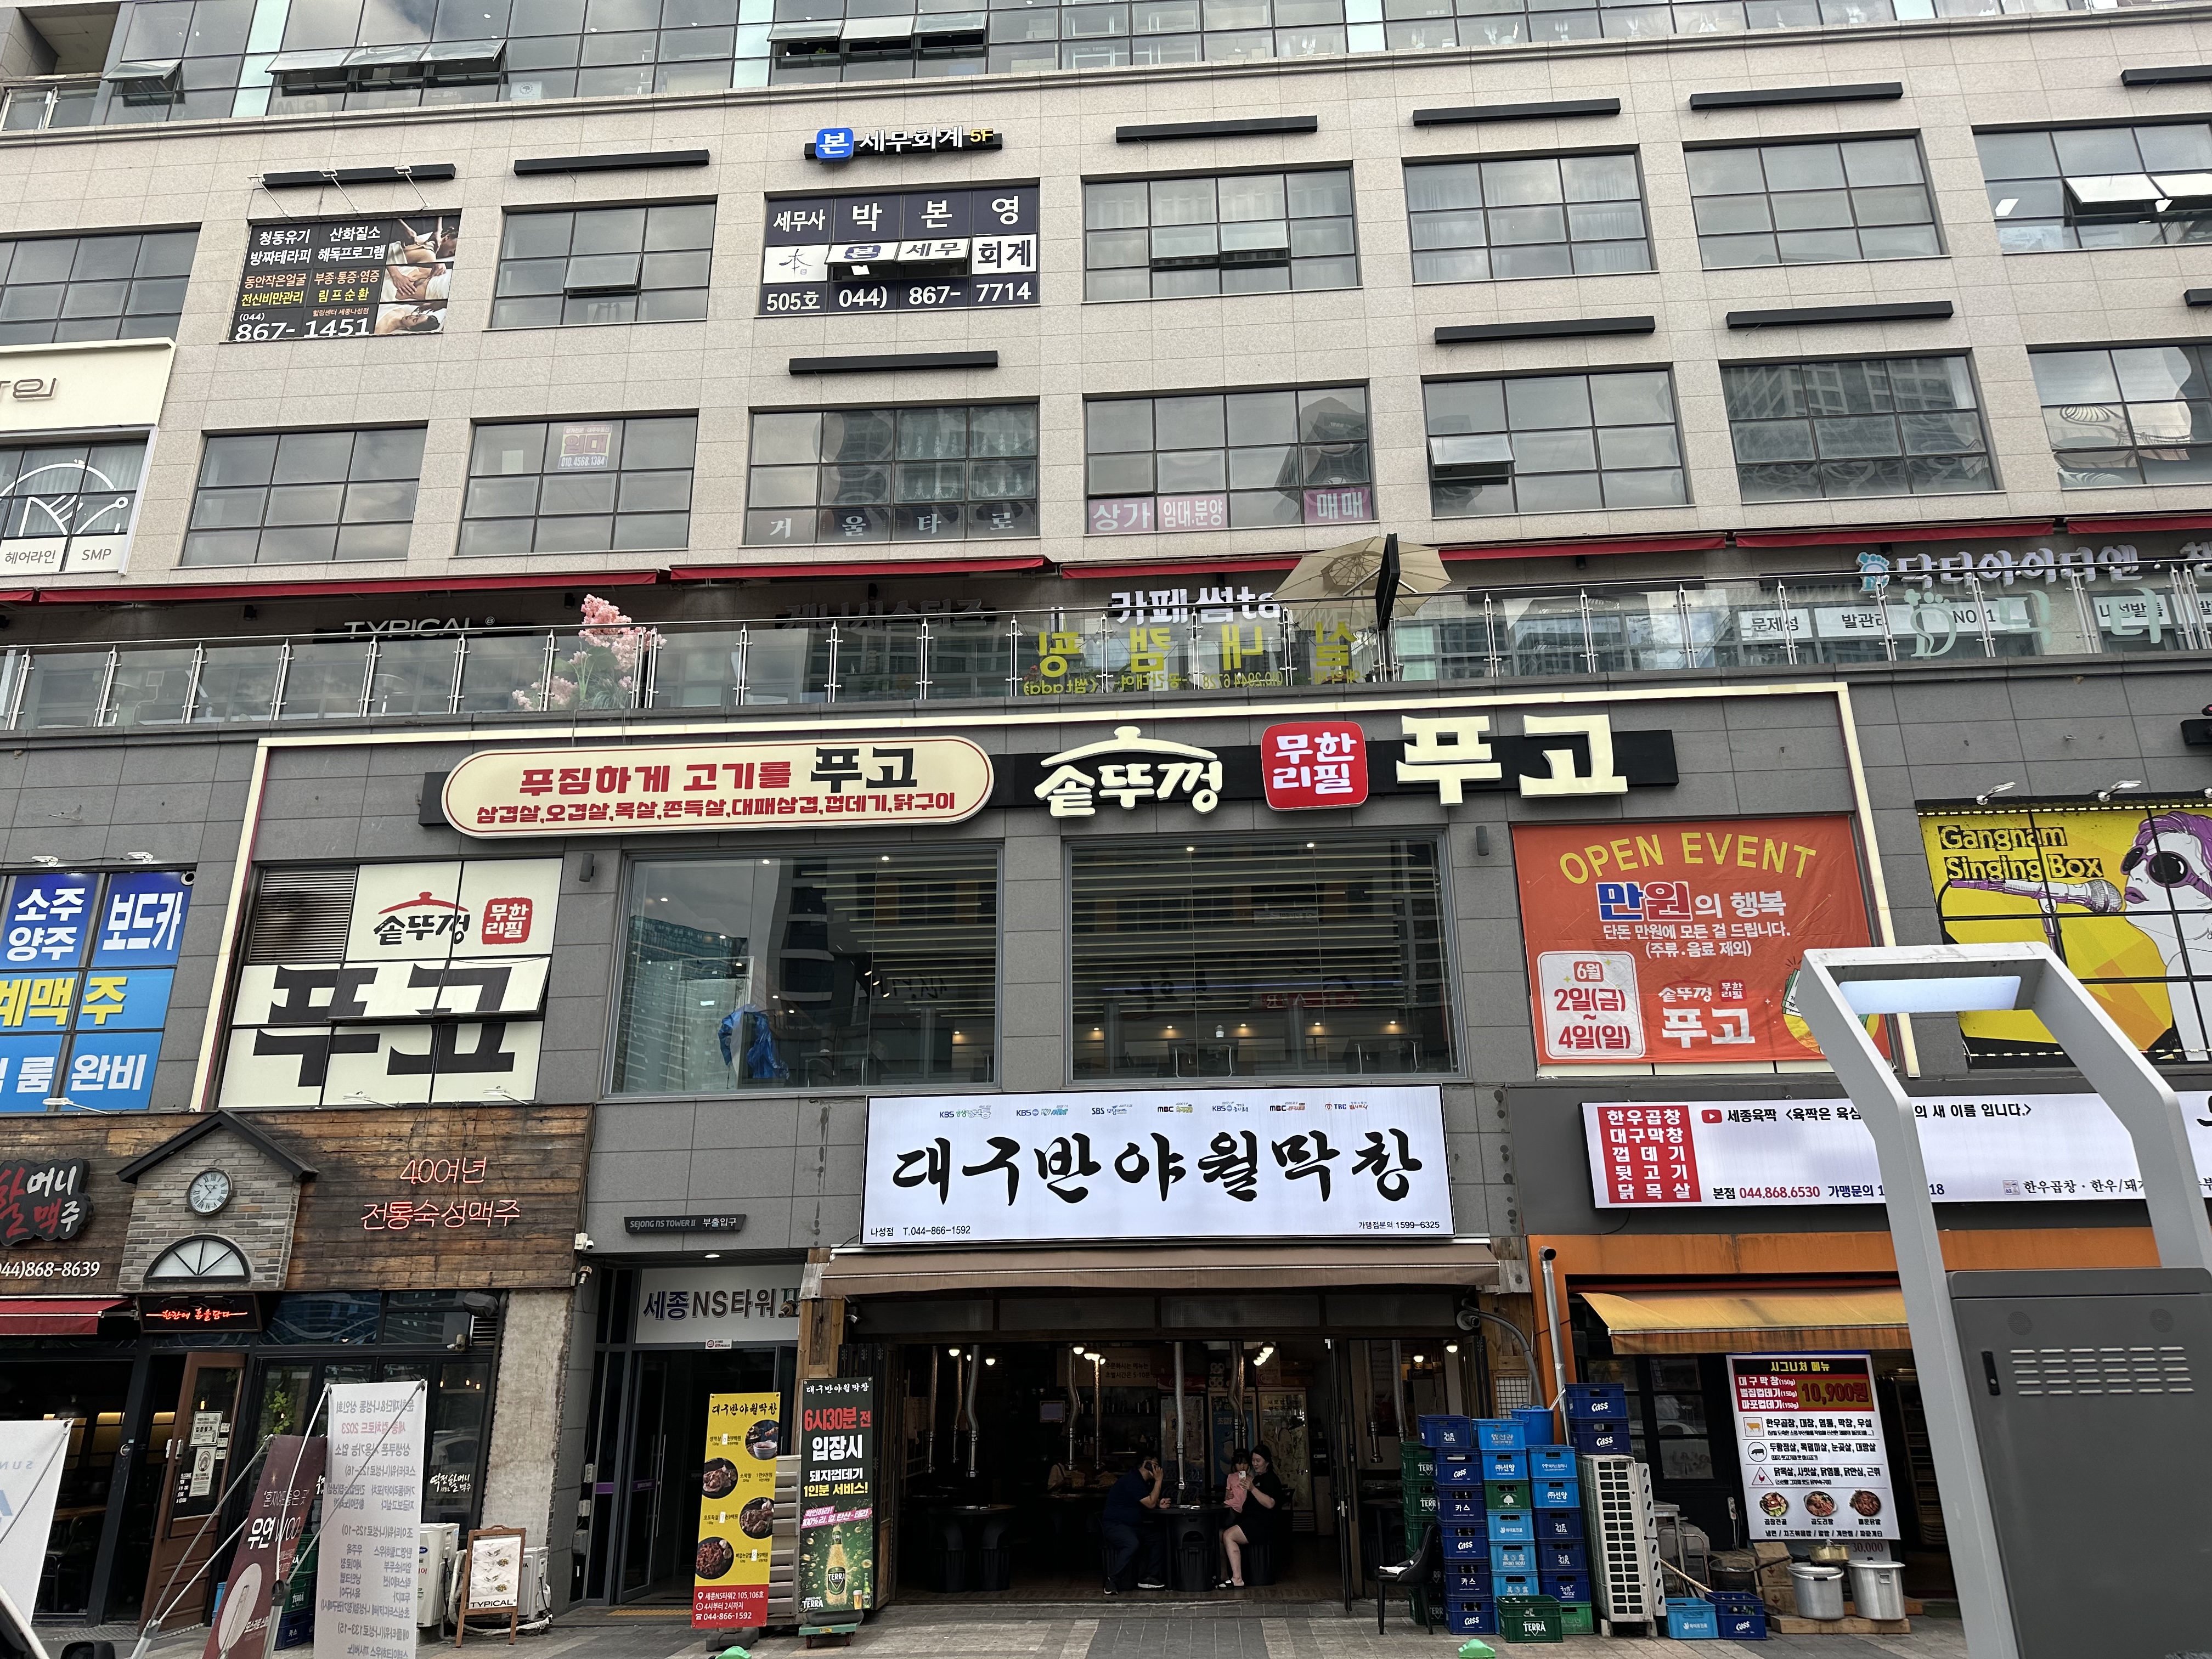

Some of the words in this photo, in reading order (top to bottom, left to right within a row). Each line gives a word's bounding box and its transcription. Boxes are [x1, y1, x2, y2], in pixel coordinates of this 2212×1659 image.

[819, 132, 850, 155] 본
[859, 126, 963, 153] 세무회계
[969, 128, 994, 143] 5F
[773, 209, 826, 232] 세무사
[258, 228, 311, 246] 청동유기
[329, 225, 381, 242] 산화질소
[250, 248, 312, 267] 방짜테라피
[317, 244, 386, 263] 해독프로그램
[905, 242, 962, 257] 세무
[978, 239, 1032, 268] 회계
[244, 272, 307, 290] 동안작은얼굴
[240, 289, 304, 307] 전신비만관리
[766, 290, 821, 312] 505호
[838, 286, 888, 309] 044)
[909, 285, 961, 305] 867-
[976, 281, 1031, 302] 7714
[239, 312, 265, 321] (044)
[303, 318, 370, 338] 1451
[564, 435, 609, 454] 임대
[561, 455, 606, 467] 010.4568.1384
[1316, 492, 1363, 520] 매매
[1092, 503, 1150, 532] 상가
[4, 549, 57, 565] 헤어라인
[81, 548, 112, 562] SMP
[343, 617, 483, 640] TYPICAL
[1274, 731, 1356, 763] 무한
[1396, 714, 1629, 806] 푸고
[518, 763, 672, 797] 푸짐하게
[683, 760, 791, 792] 고기를
[810, 746, 918, 794] 푸고
[1272, 765, 1356, 795] 리필
[1034, 761, 1223, 819] 솥뚜껑
[1939, 826, 2067, 851] Gangnam
[1559, 833, 1664, 885] OPEN
[1681, 832, 1817, 879] EVENT
[1946, 856, 2044, 882] Singing
[2047, 854, 2104, 878] Box
[14, 887, 86, 922] 소주
[1595, 881, 1723, 923] 만원의
[1730, 890, 1787, 918] 행복
[102, 891, 184, 951] 보드카
[489, 903, 529, 921] 무한
[374, 914, 471, 946] 솥뚜껑
[485, 922, 527, 939] 리필
[1602, 924, 1632, 940] 단돈
[1634, 923, 1677, 940] 만원에
[1680, 923, 1709, 939] 모든
[1711, 923, 1727, 939] 걸
[1731, 921, 1791, 938] 드립니다.
[7, 926, 77, 962] 양주
[1719, 939, 1752, 957] 제외)
[1576, 962, 1602, 980] 6월
[1657, 985, 1713, 1003] 솥뚜껑
[1720, 981, 1744, 991] 무한
[1720, 991, 1744, 1000] 리필
[1554, 987, 1627, 1012] 2일(금)
[253, 962, 516, 1088] 푸고
[1661, 1006, 1756, 1049] 푸고
[1558, 1024, 1631, 1049] 4일(일)
[70, 1053, 148, 1092] 완비
[1606, 1108, 1681, 1126] 한우곱창
[1727, 1108, 1777, 1123] 세종육짝
[1933, 1105, 1946, 1119] 새
[1950, 1104, 1977, 1118] 이름
[1610, 1127, 1684, 1144] 대구막창
[1612, 1146, 1686, 1163] 껍데기
[399, 1156, 487, 1184] 40여년
[892, 1127, 1423, 1206] 대구반야월막창
[1615, 1164, 1689, 1182] 뒷고기
[1617, 1182, 1691, 1200] 닭목살
[1712, 1187, 1736, 1200] 본점
[1739, 1186, 1821, 1199] 044.868.6530
[1827, 1184, 1874, 1198] 가맹문의
[2023, 1180, 2077, 1194] 한우곱창
[360, 1199, 521, 1231] 전통숙성맥주
[702, 1217, 737, 1227] 부출입구
[871, 1227, 894, 1237] 나성점
[1358, 1221, 1393, 1229] 가맹점문의
[1395, 1221, 1440, 1229] 1599-6325
[0, 1260, 100, 1279] 44)868-8639
[1771, 1361, 1808, 1373] 시그니처
[1811, 1361, 1830, 1372] 메뉴
[806, 1382, 870, 1395] 대구반야월막창
[1801, 1382, 1870, 1405] 10,900원
[712, 1402, 777, 1417] 대구반야월막창
[804, 1406, 857, 1432] 6시30분
[859, 1410, 871, 1427] 전
[811, 1435, 863, 1462] 입장시
[809, 1467, 864, 1482] 돼지껍데기
[803, 1483, 830, 1498] 1인분
[832, 1481, 868, 1496] 서비스!
[828, 1573, 845, 1581] TERRA
[470, 1598, 514, 1608] TYPICAL
[704, 1592, 736, 1601] 세종NS타워2
[704, 1602, 724, 1611] 4시부터
[724, 1601, 744, 1610] 2시까지
[802, 1600, 823, 1608] TERRA
[703, 1611, 752, 1620] 044-866-1592
[1522, 1621, 1547, 1633] TERRA
